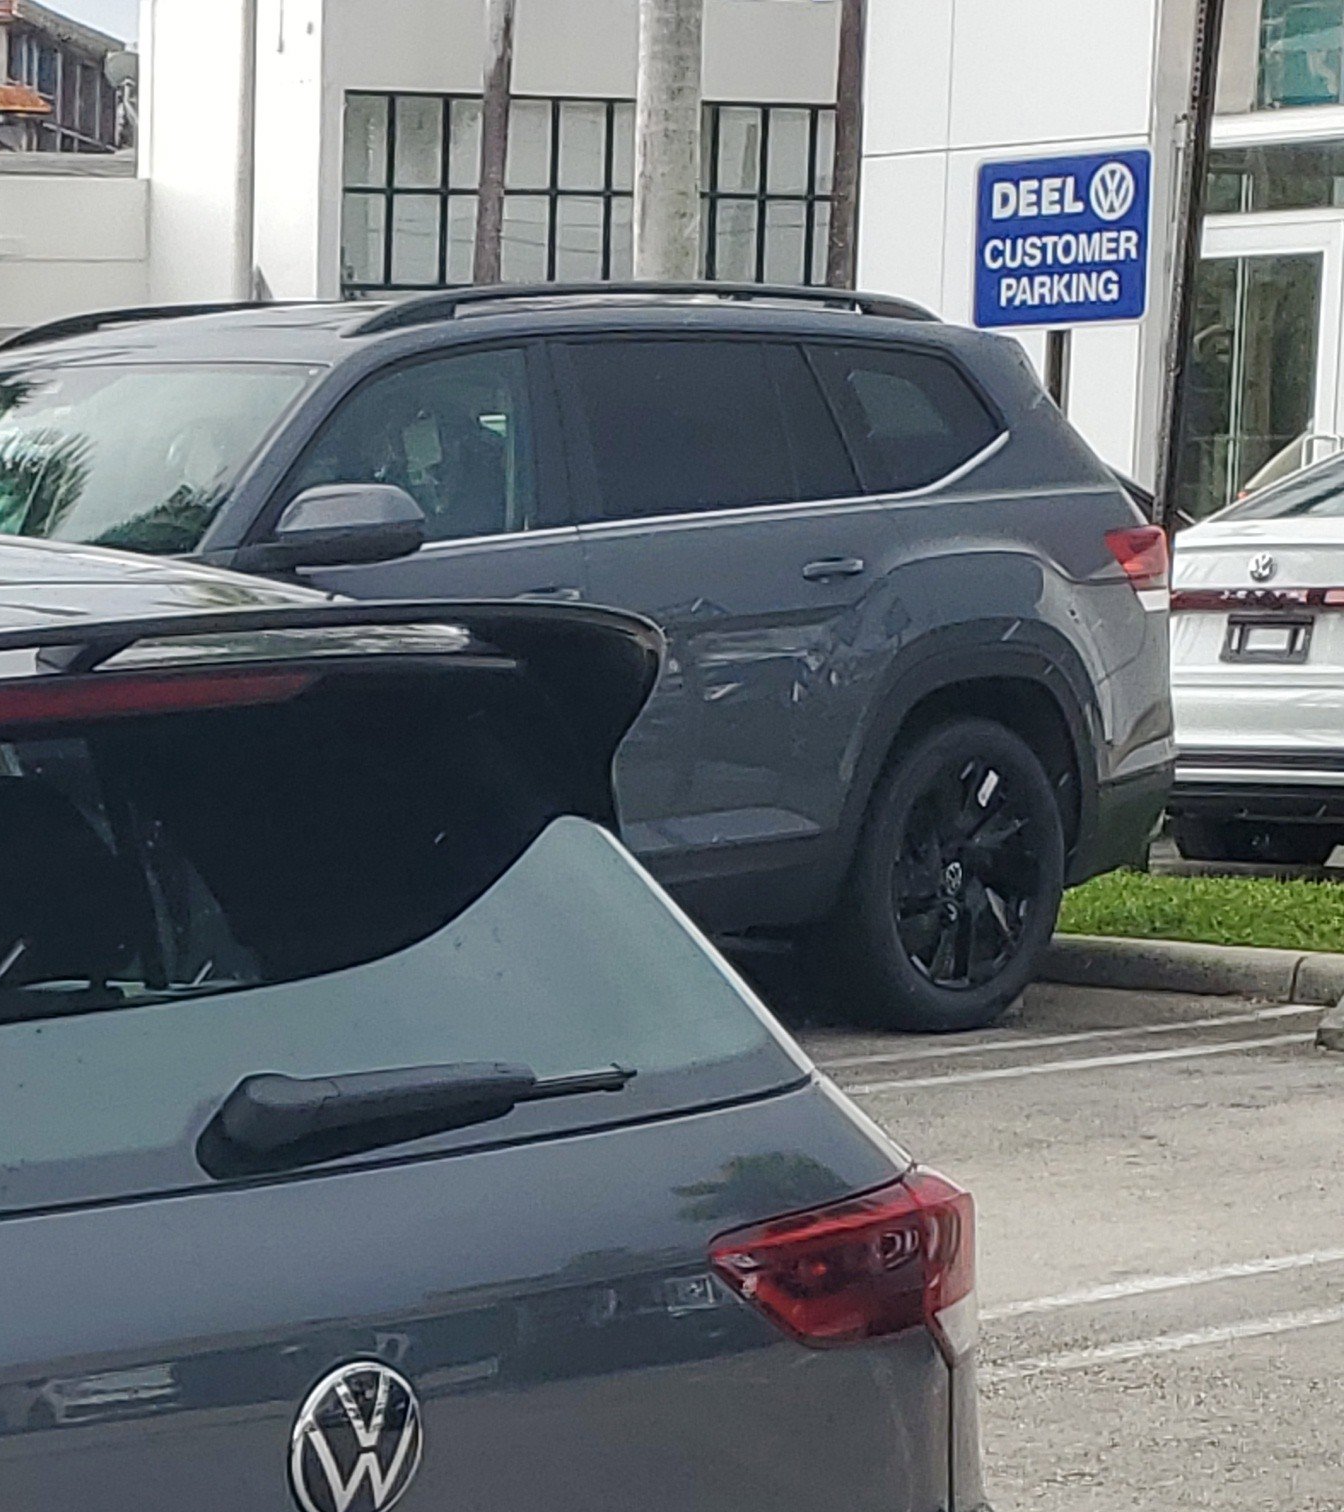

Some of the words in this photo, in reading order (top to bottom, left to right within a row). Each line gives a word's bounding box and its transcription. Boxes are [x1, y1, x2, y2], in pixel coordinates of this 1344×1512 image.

[992, 176, 1085, 220] DEEL
[1089, 162, 1135, 221] VW
[984, 230, 1139, 269] CUSTOMER
[1000, 270, 1120, 307] PARKING
